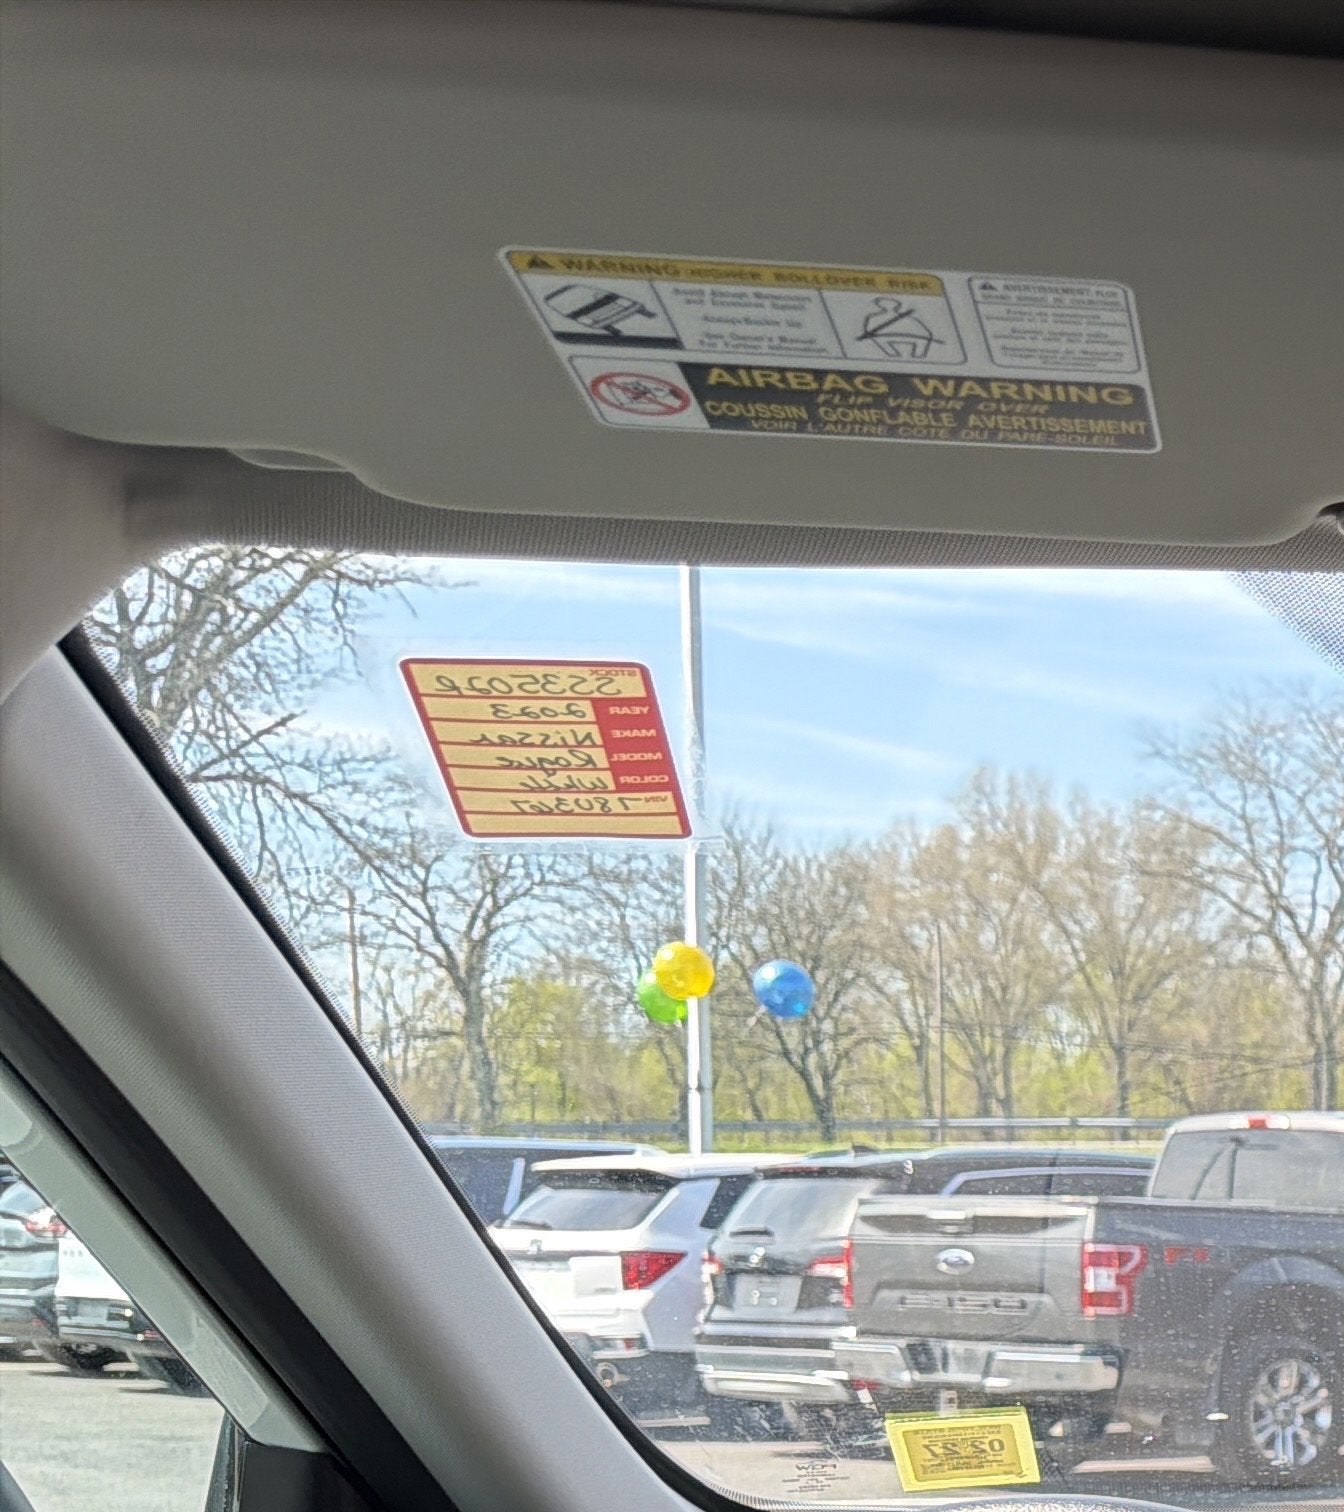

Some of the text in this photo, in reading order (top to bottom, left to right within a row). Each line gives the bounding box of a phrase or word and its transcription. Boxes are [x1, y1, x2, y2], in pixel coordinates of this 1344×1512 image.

[559, 258, 682, 277] WARNING
[707, 366, 1136, 406] AIRBAG WARNING
[704, 400, 1148, 435] COUSSIN GONFLABLE AVERTISSEMENT
[817, 395, 874, 407] FLIP
[976, 401, 1049, 415] OVER
